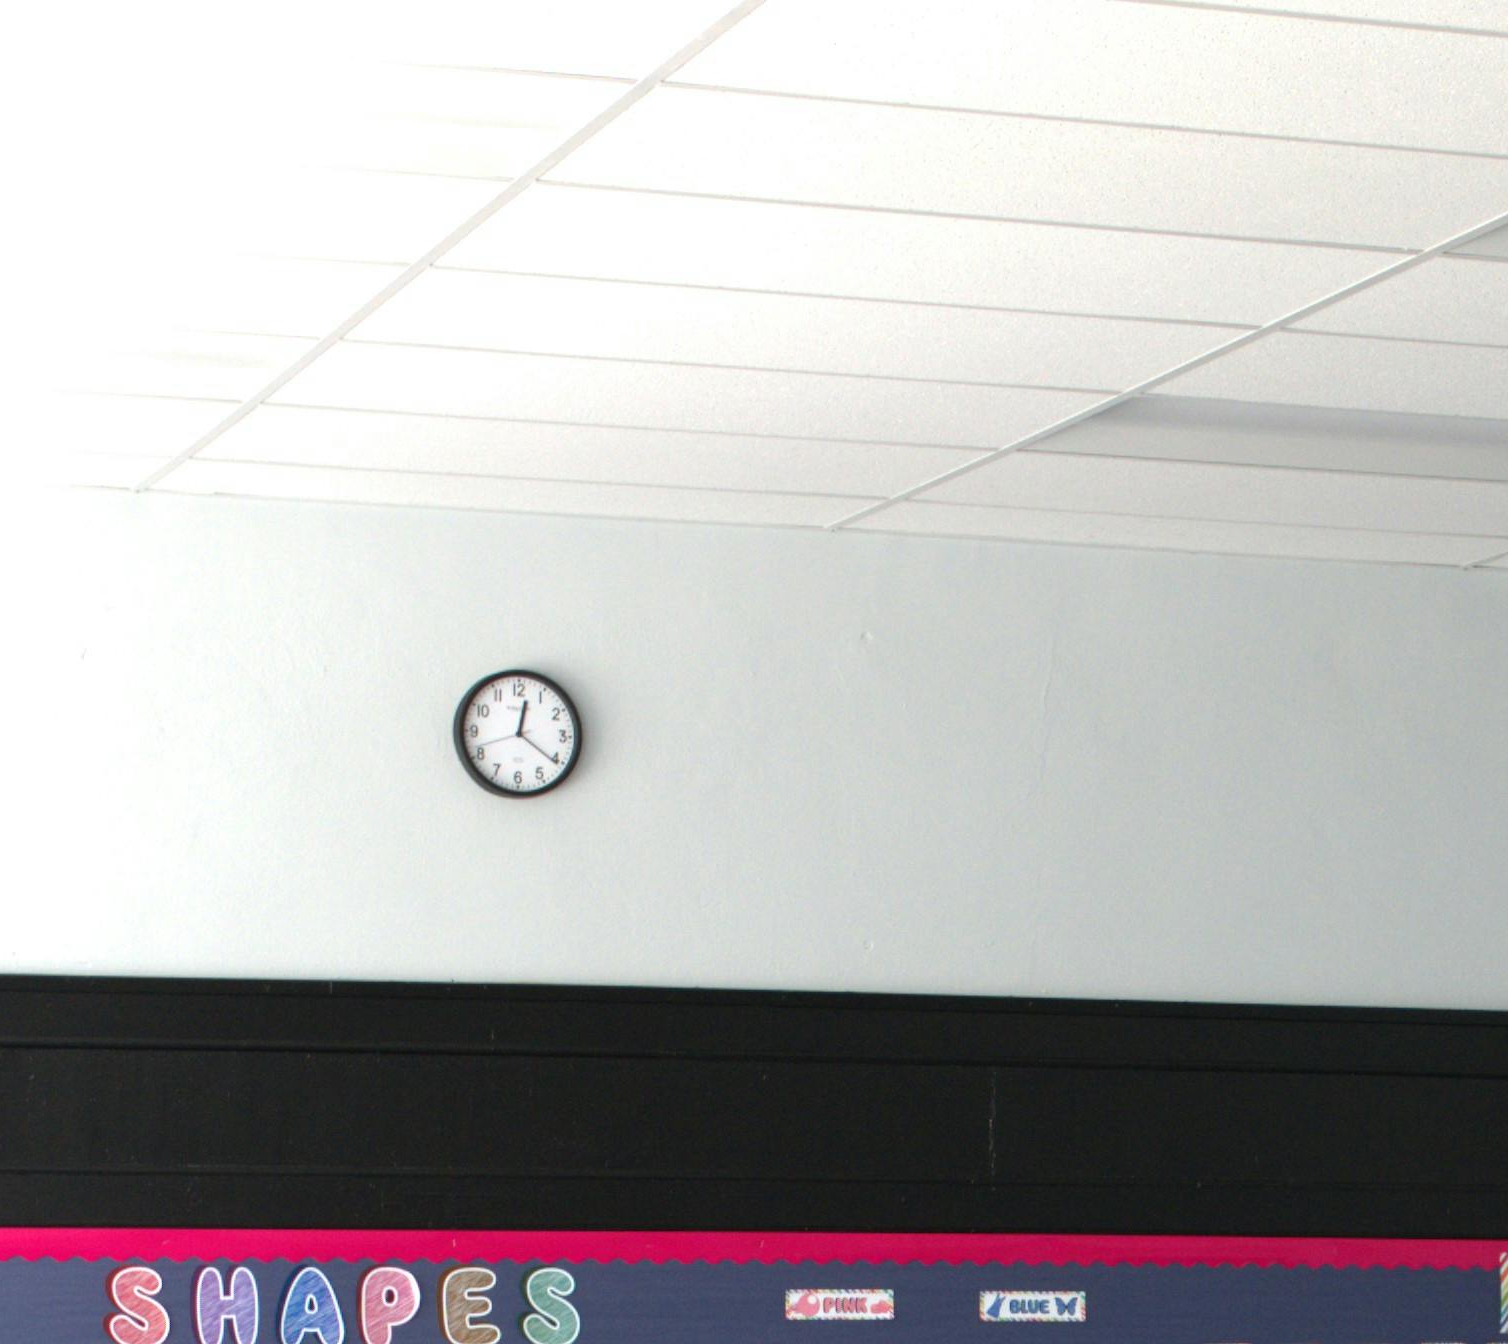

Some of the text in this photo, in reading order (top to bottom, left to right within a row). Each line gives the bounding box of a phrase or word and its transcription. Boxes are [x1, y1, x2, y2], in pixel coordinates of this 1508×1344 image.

[494, 689, 502, 702] 11
[513, 683, 525, 696] 12
[477, 705, 489, 717] 10
[552, 708, 561, 720] 2
[470, 725, 478, 737] 9
[559, 729, 567, 742] 3
[477, 748, 484, 760] 8
[552, 752, 560, 764] 4
[494, 763, 501, 776] 7
[536, 767, 544, 779] 5
[514, 772, 522, 784] 6
[822, 1298, 867, 1314] PINK
[1008, 1299, 1050, 1314] BLUE
